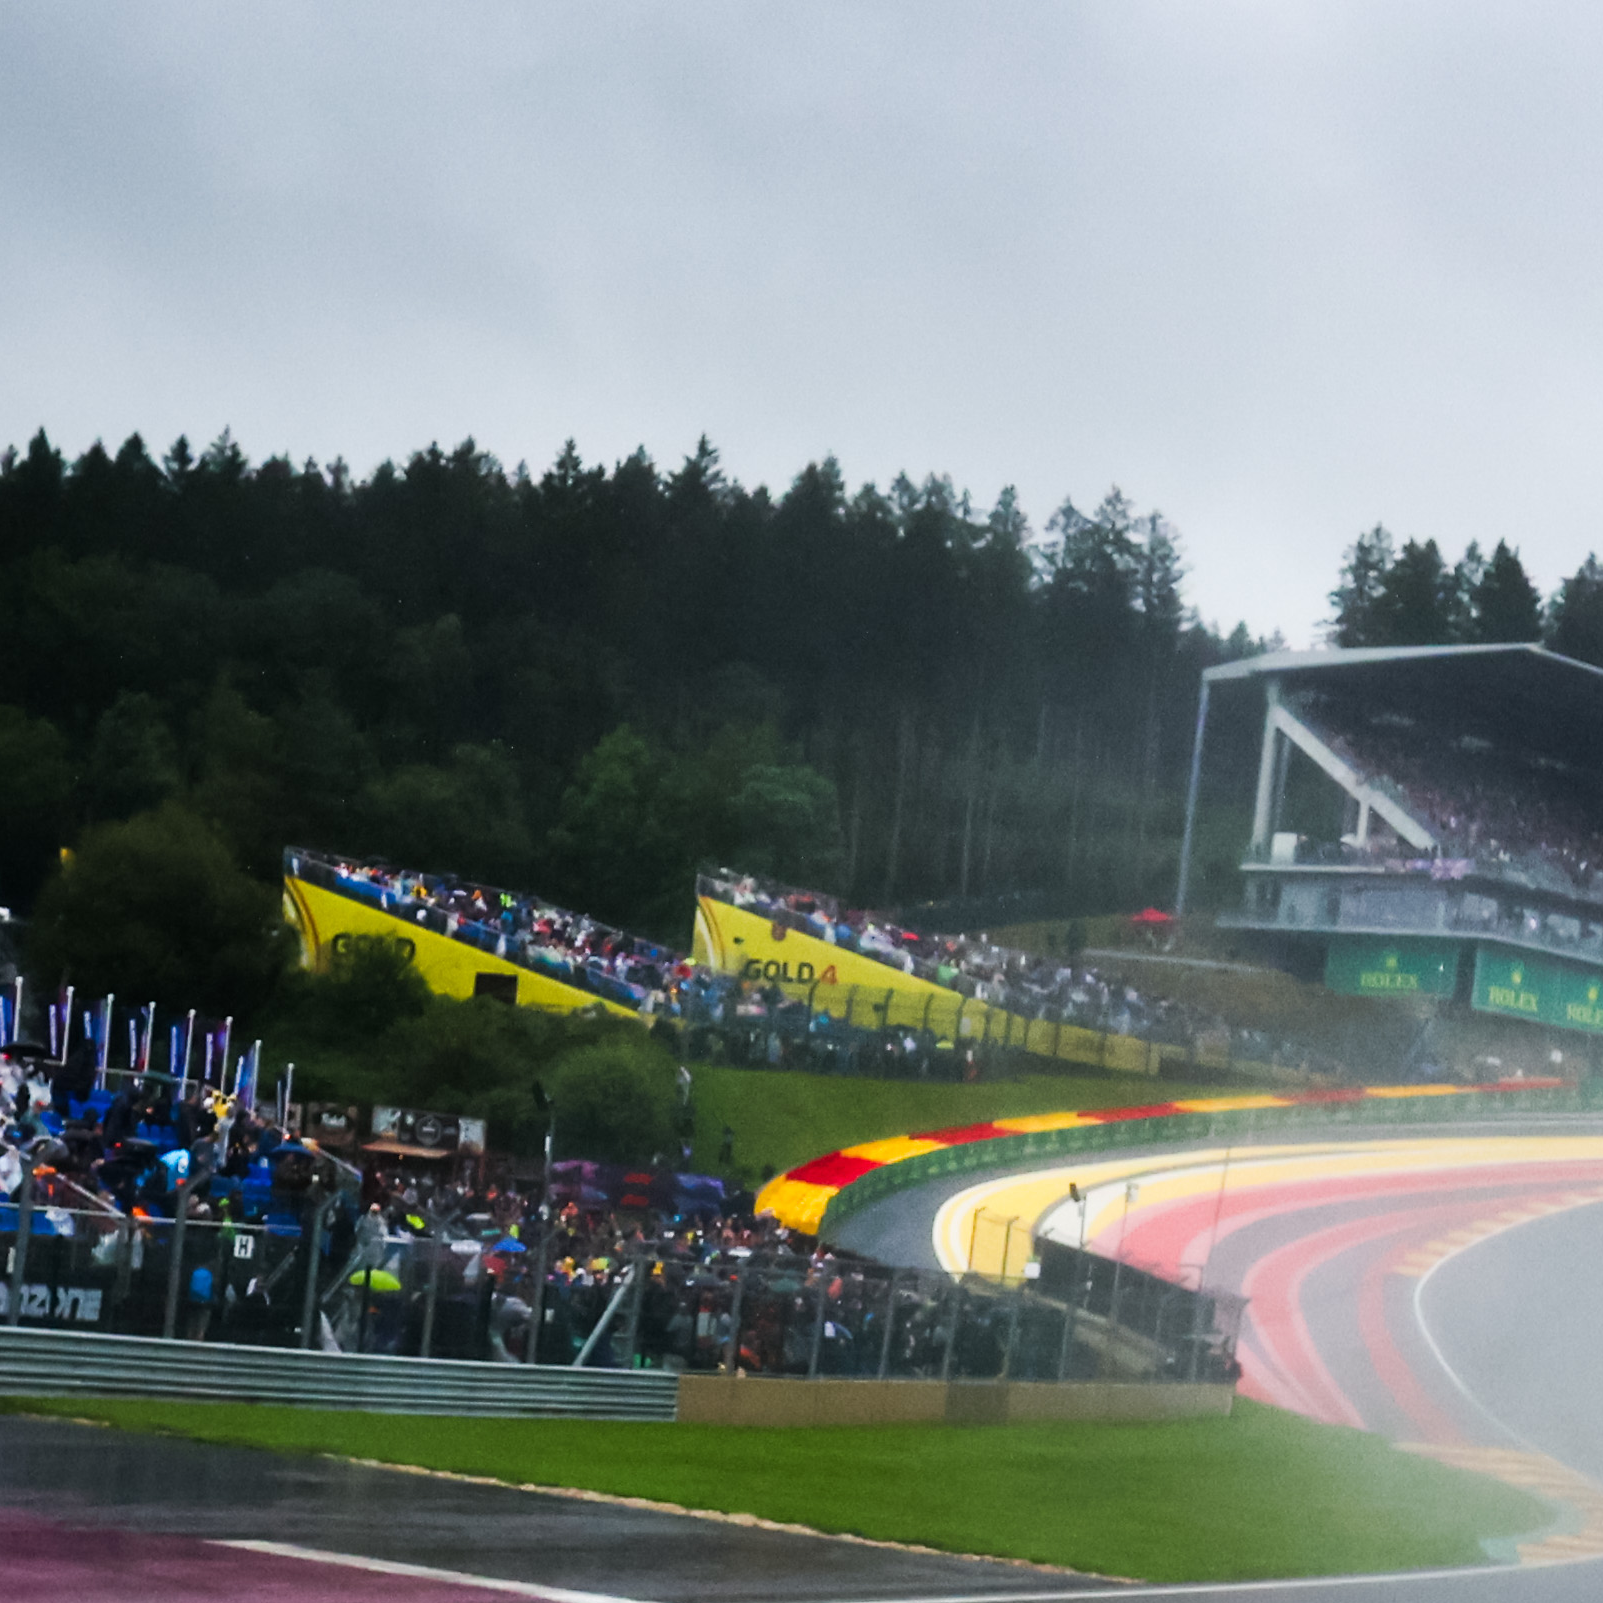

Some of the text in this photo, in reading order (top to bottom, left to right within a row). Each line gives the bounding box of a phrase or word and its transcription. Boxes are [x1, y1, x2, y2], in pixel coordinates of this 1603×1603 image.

[744, 958, 838, 985] GOLD 4
[238, 1237, 250, 1256] H
